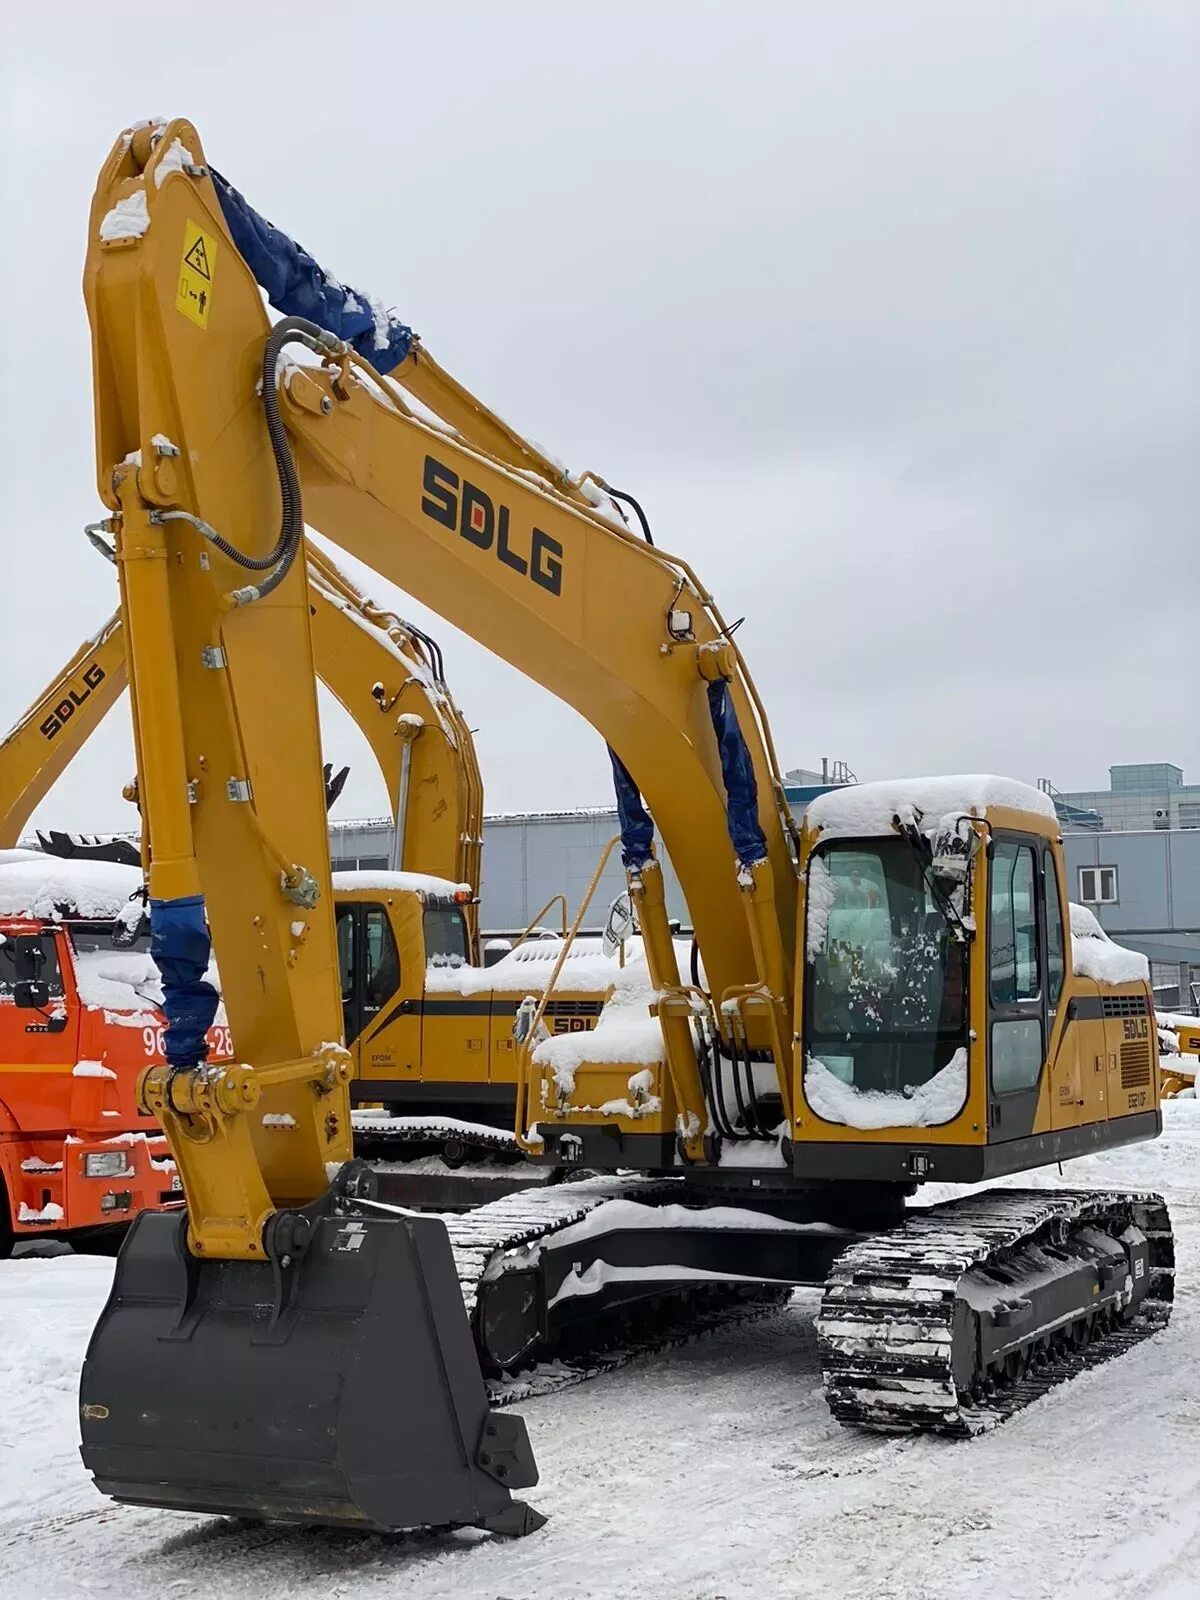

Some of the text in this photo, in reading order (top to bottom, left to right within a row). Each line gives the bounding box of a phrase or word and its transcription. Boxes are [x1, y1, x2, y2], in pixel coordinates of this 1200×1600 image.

[422, 454, 563, 597] SDLG
[40, 663, 106, 741] SDLG
[554, 1018, 596, 1032] SDL
[1123, 1018, 1148, 1040] SDLG
